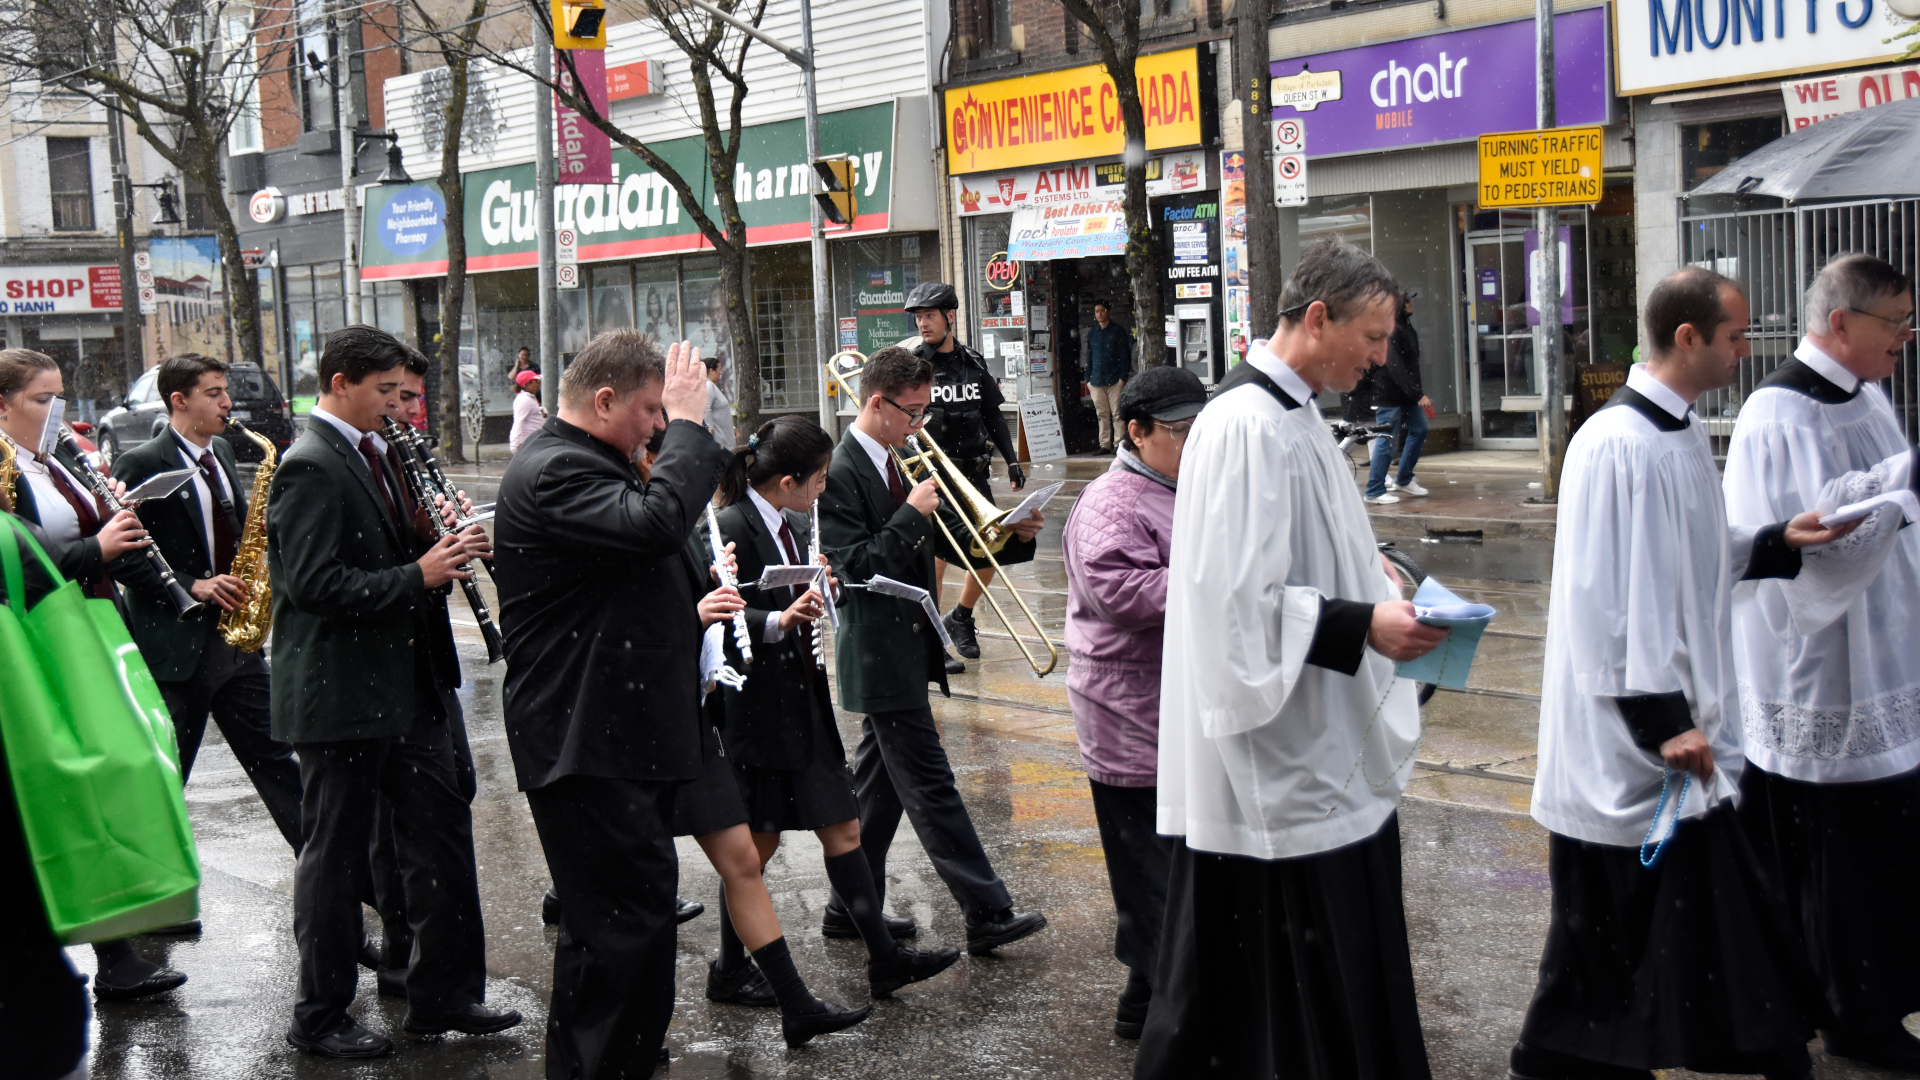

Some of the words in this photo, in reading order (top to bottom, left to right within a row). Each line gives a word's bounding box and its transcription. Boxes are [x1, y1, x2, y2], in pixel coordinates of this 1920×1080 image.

[1276, 81, 1299, 92] Village
[1299, 80, 1304, 89] of
[1306, 79, 1334, 89] Parkdale
[1370, 52, 1467, 107] chatr
[1283, 91, 1307, 103] QUEEN
[1795, 80, 1839, 104] WE
[952, 84, 1095, 156] CONVENIENCE
[1376, 109, 1413, 130] MOBILE
[1482, 138, 1538, 158] TURNING
[1542, 134, 1599, 154] TRAFFIC
[1500, 160, 1535, 178] MUST
[1541, 158, 1580, 176] YIELD
[1035, 166, 1090, 195] ATM
[1034, 193, 1072, 204] SYSTEMS
[1074, 191, 1092, 200] LTD.
[1484, 184, 1500, 201] TO
[1505, 179, 1596, 200] PEDESTRIANS
[255, 203, 272, 215] A&W
[392, 202, 407, 214] Your
[407, 197, 434, 213] Friendly
[1044, 206, 1068, 219] Best
[1071, 202, 1102, 216] Rates
[387, 212, 438, 231] Neighbourhood
[395, 232, 428, 245] Pharmacy
[1021, 237, 1064, 248] Worldwide
[1094, 233, 1125, 242] Service
[1174, 241, 1191, 249] COURIER
[1191, 240, 1207, 248] SERVICE
[1063, 247, 1079, 255] India
[1091, 243, 1111, 253] Lanka
[242, 256, 265, 265] &W
[987, 260, 1017, 280] OPEN
[1168, 267, 1186, 278] LOW
[1186, 266, 1200, 277] FEE
[1201, 265, 1218, 276] ATM
[6, 279, 85, 299] SHOP
[858, 289, 905, 305] Guardian
[876, 318, 890, 328] Free
[868, 328, 900, 338] Medication
[1581, 370, 1625, 386] STUDIO
[930, 383, 981, 403] POLICE
